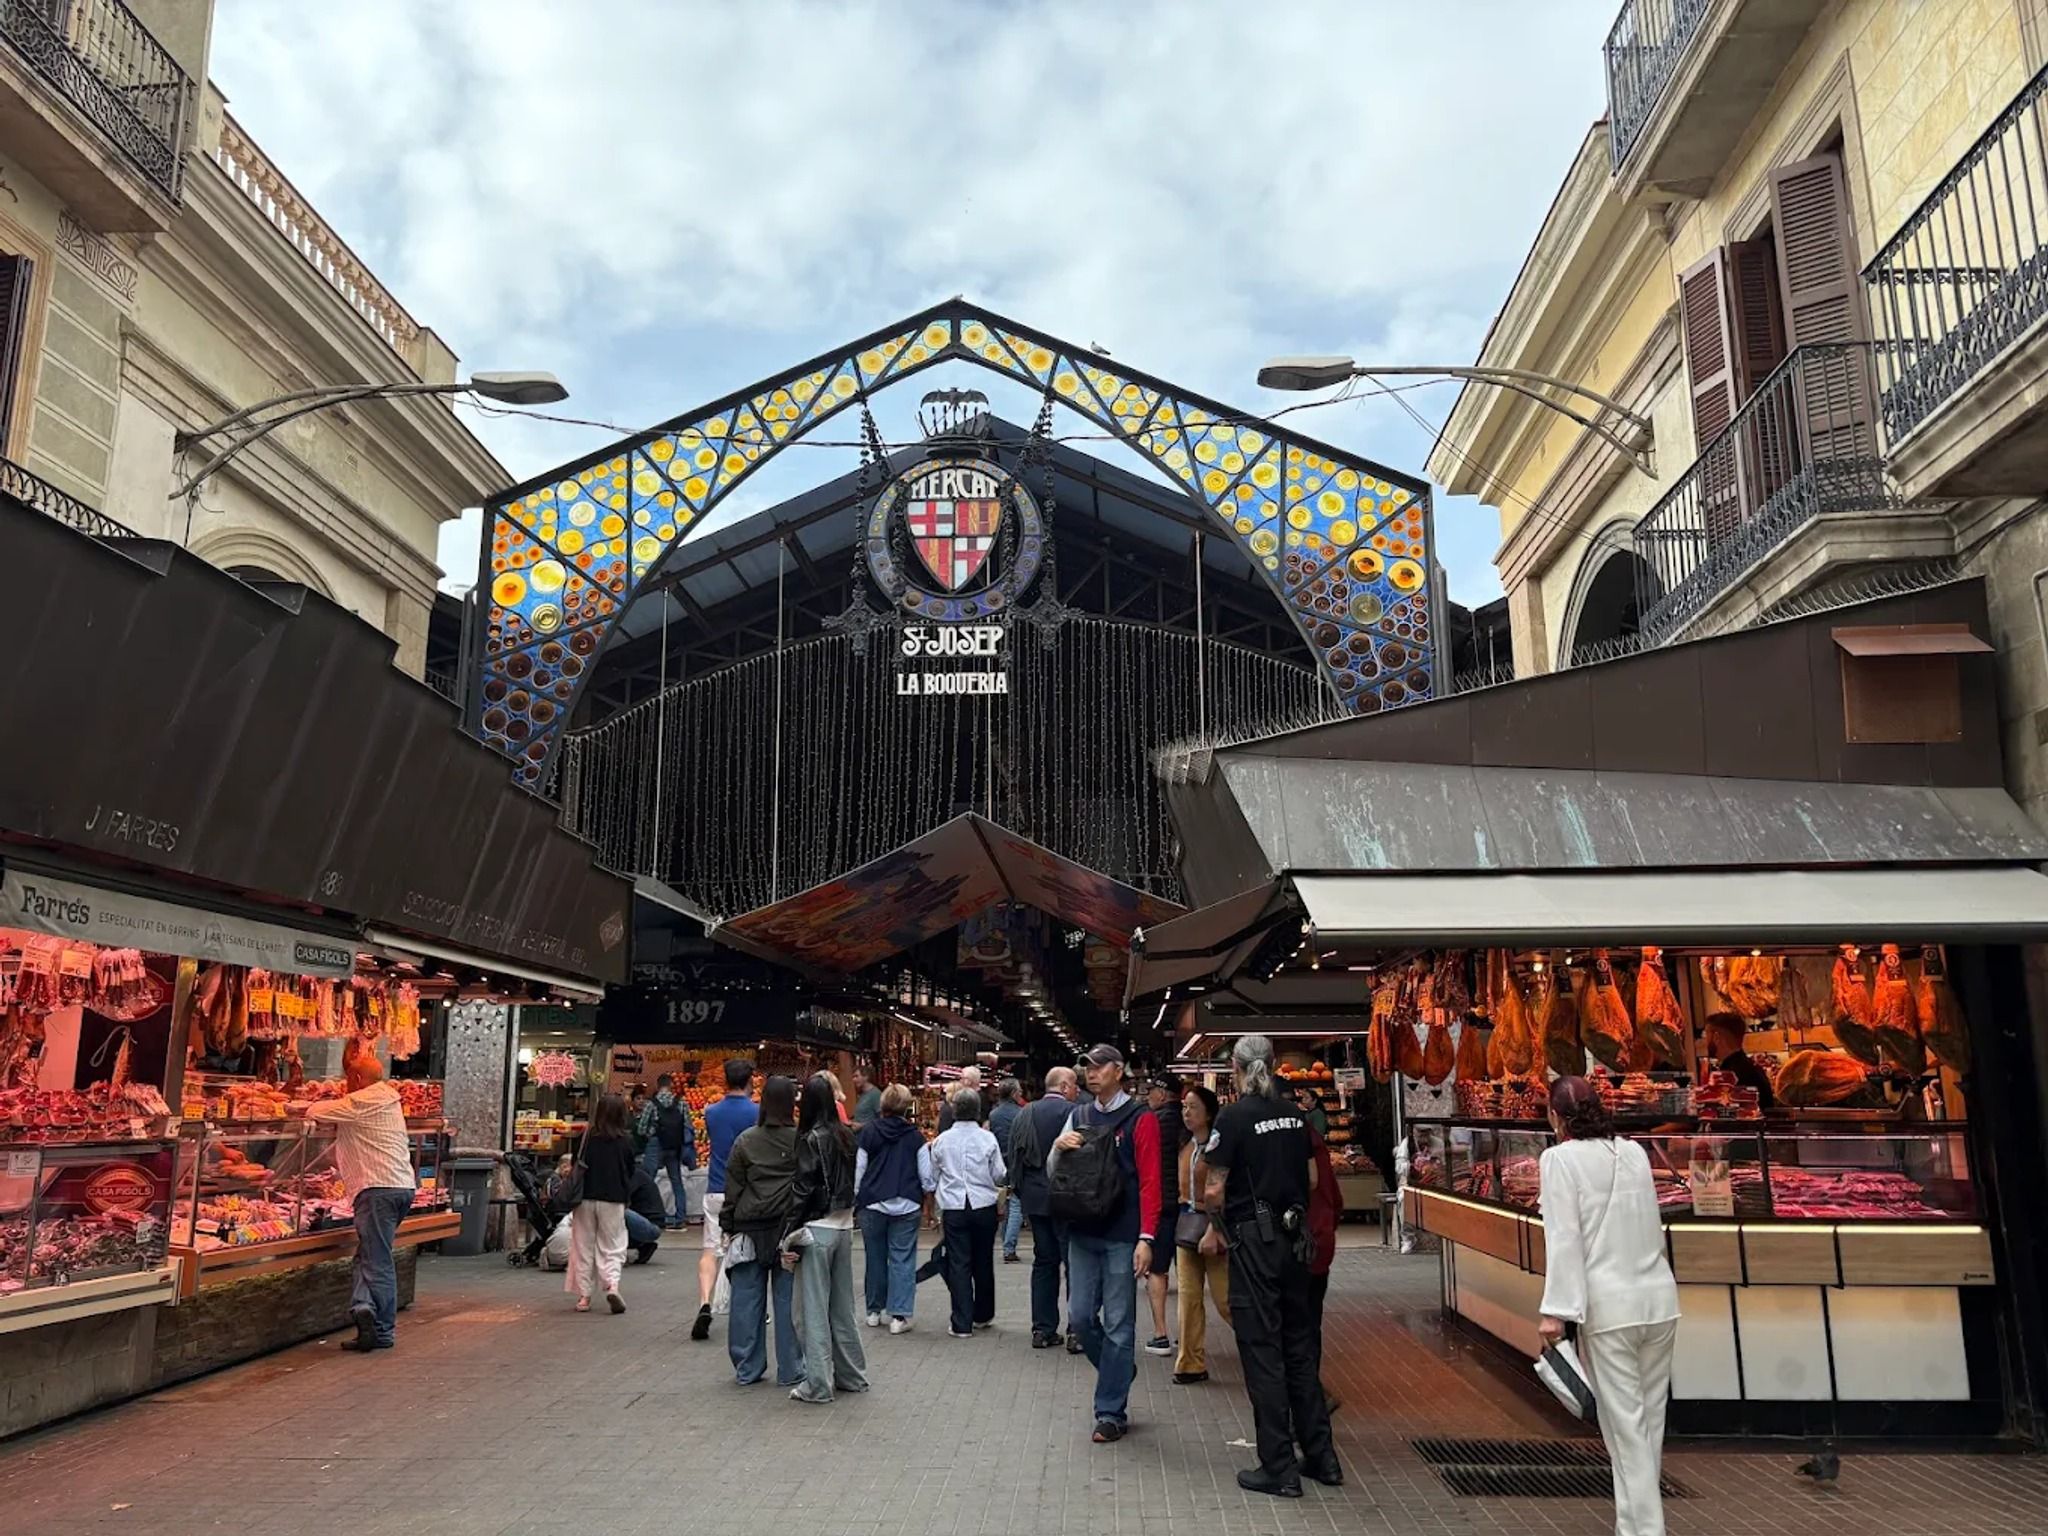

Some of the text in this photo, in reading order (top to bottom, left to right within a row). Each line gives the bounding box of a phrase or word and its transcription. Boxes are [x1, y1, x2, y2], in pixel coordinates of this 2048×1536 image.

[911, 469, 999, 499] MERCAT
[925, 625, 1004, 656] JOSEP
[897, 672, 1009, 695] LA BOQUERIA
[85, 805, 101, 831] J
[99, 912, 155, 931] ESPECIALITAT
[666, 1000, 726, 1024] 1897
